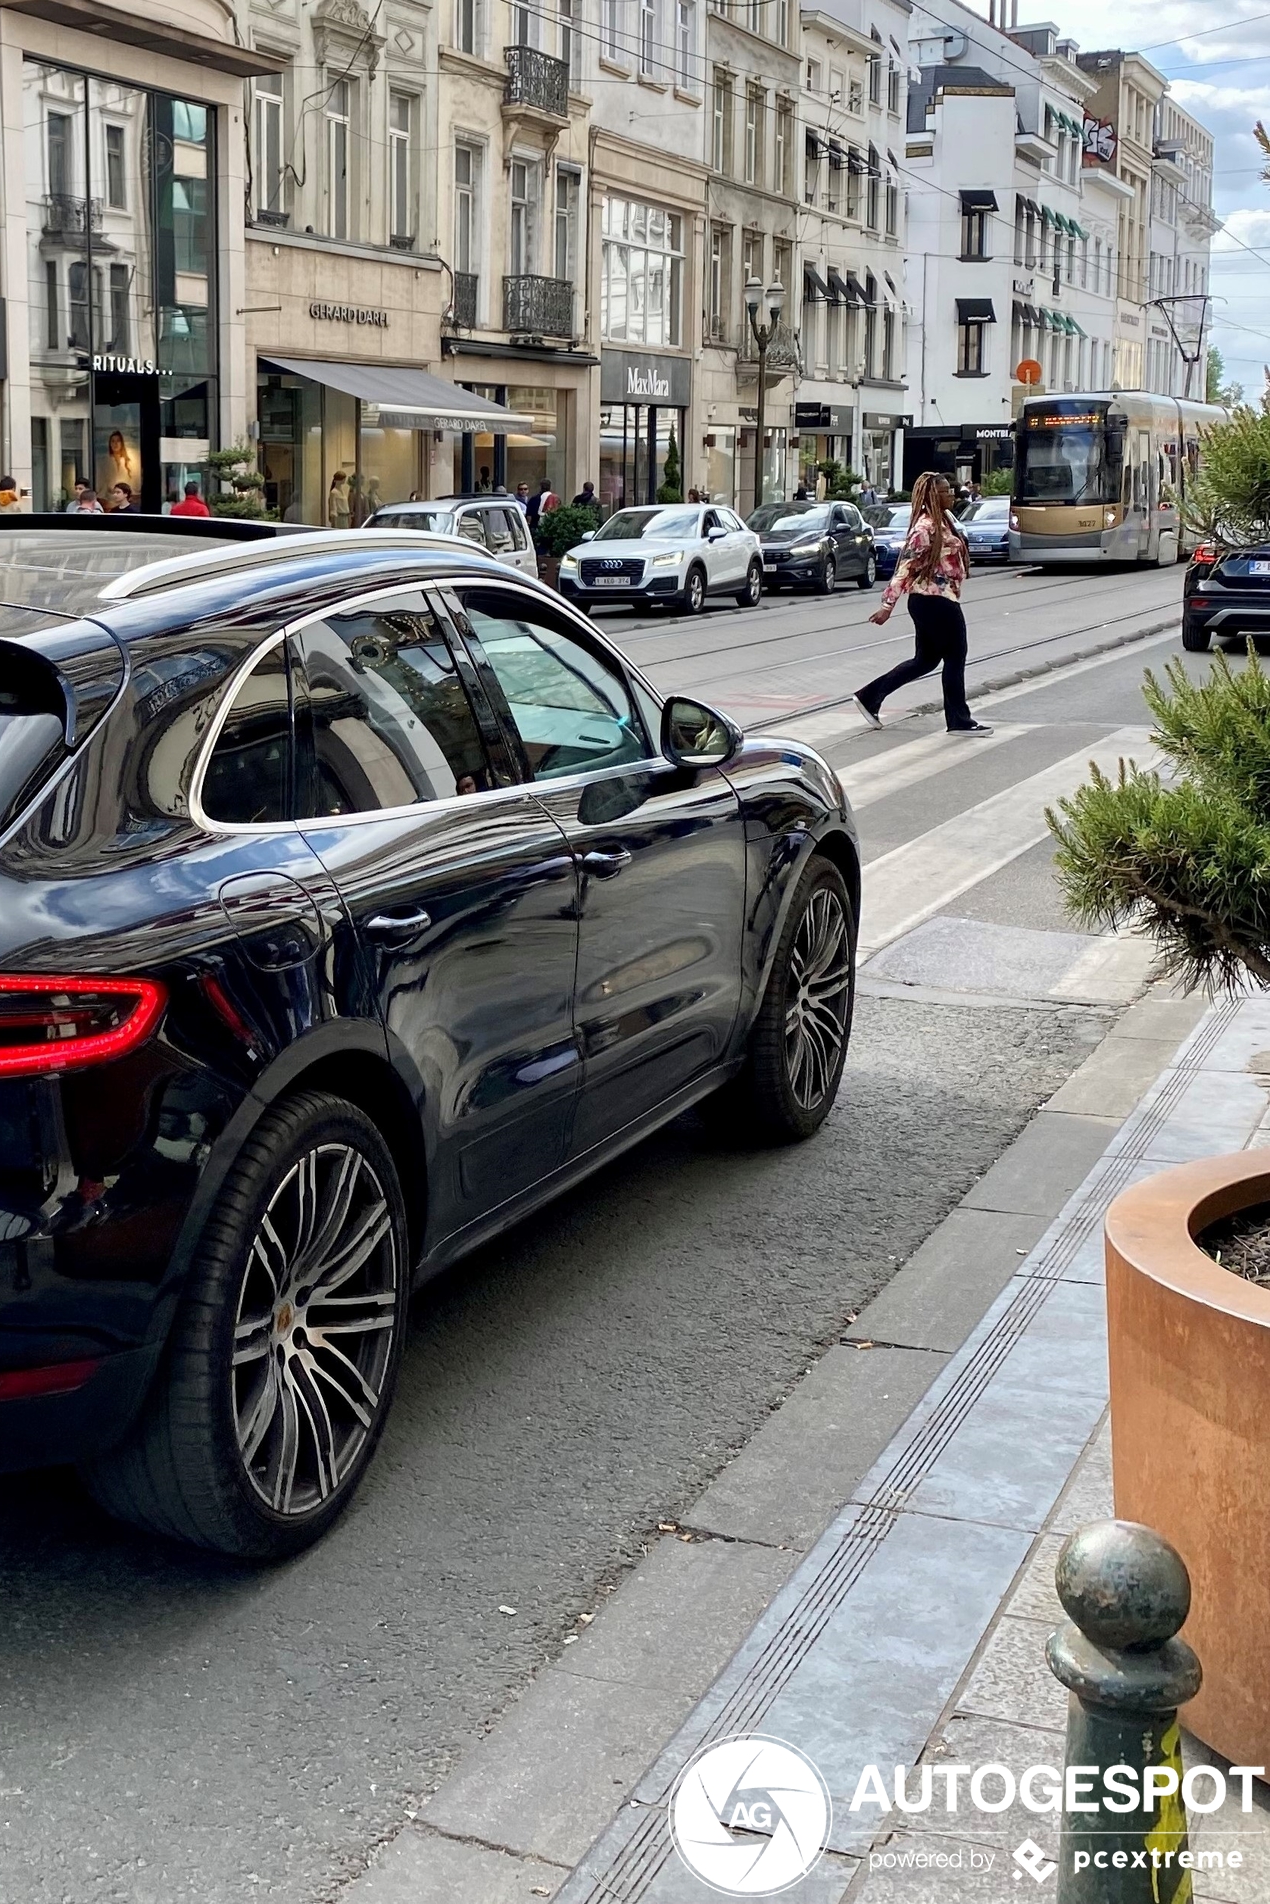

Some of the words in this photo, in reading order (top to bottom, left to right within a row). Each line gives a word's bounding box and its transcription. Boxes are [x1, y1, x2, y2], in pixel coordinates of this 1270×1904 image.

[93, 355, 173, 376] RITUALS...
[434, 417, 463, 430] GERARD
[465, 420, 488, 432] DAREL
